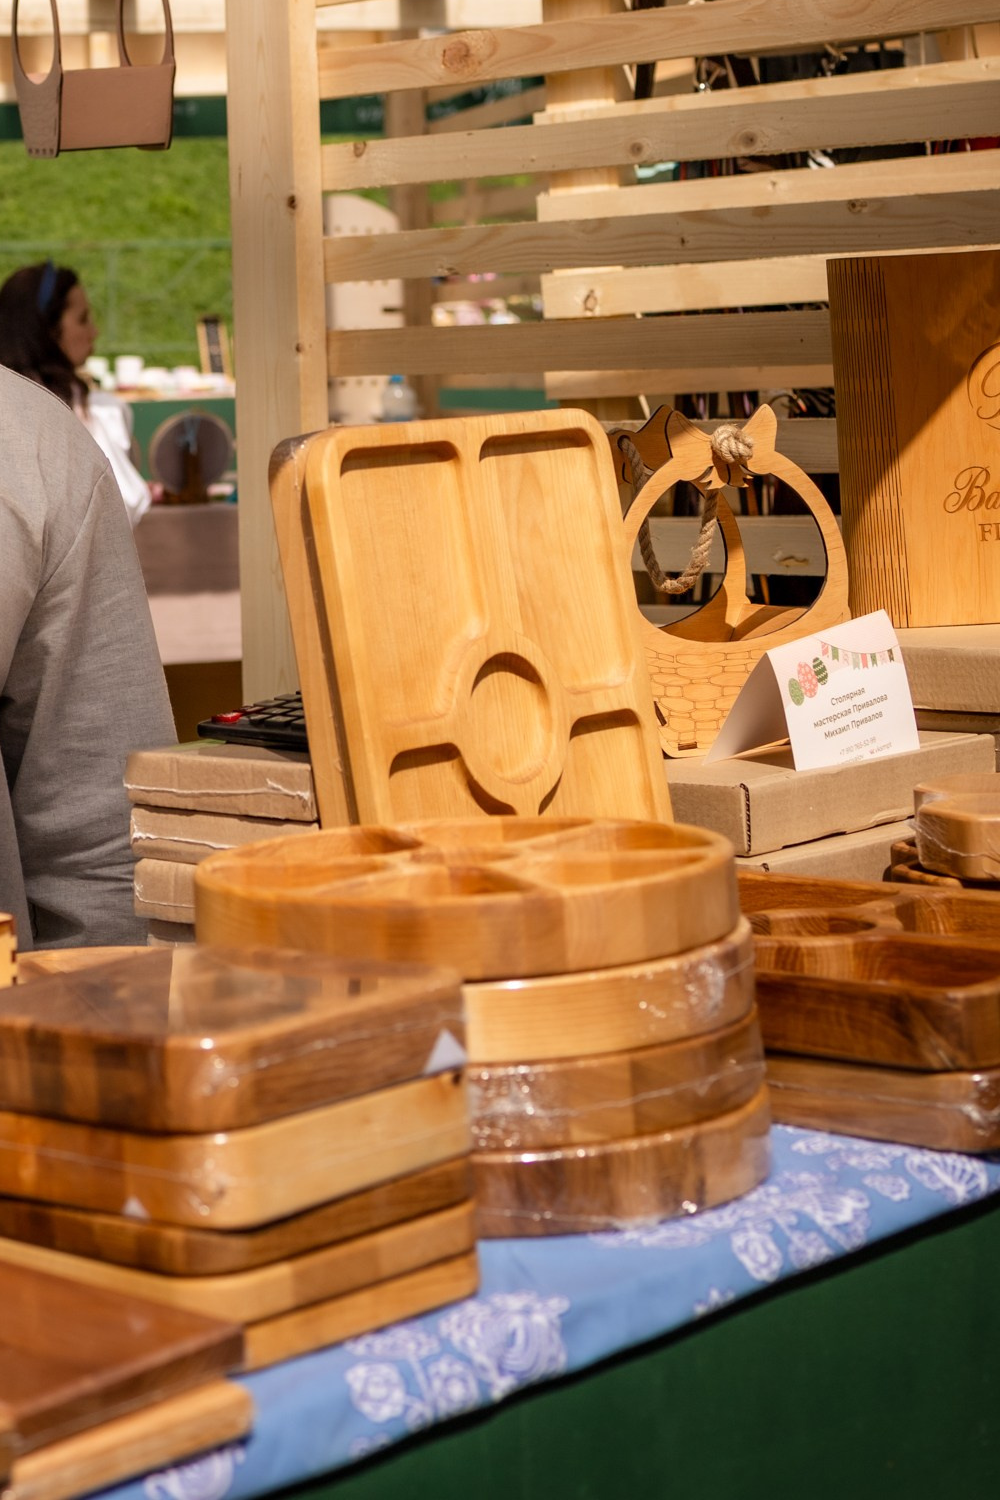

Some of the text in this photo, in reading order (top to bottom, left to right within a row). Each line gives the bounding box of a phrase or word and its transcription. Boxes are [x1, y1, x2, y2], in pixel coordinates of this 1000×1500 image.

[813, 693, 888, 728] мастерская Привалова
[831, 688, 866, 706] Столярная
[824, 710, 884, 739] Михаил Привалов
